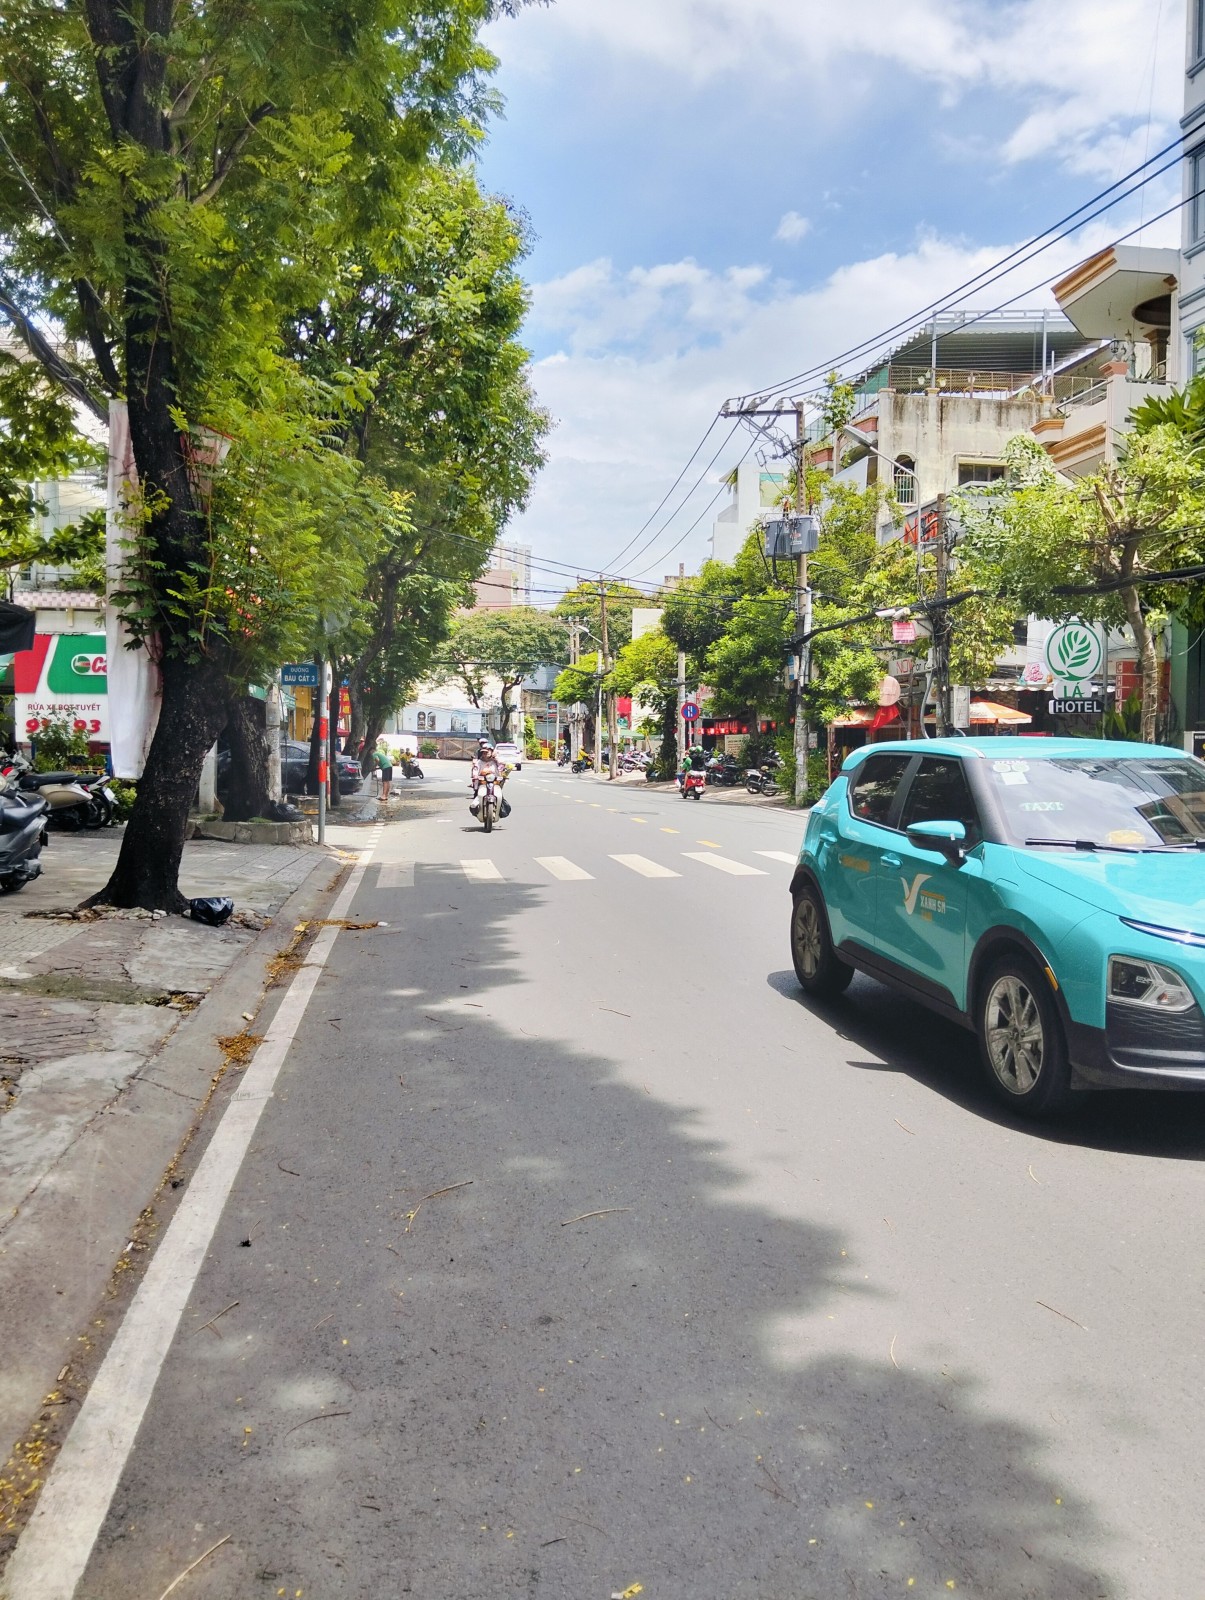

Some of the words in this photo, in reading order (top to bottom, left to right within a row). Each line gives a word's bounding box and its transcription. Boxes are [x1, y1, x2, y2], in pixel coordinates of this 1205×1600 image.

[1063, 682, 1083, 698] LÁ
[27, 702, 44, 711] RỬA
[75, 702, 101, 711] TUYẾT
[1055, 701, 1101, 712] HOTEL
